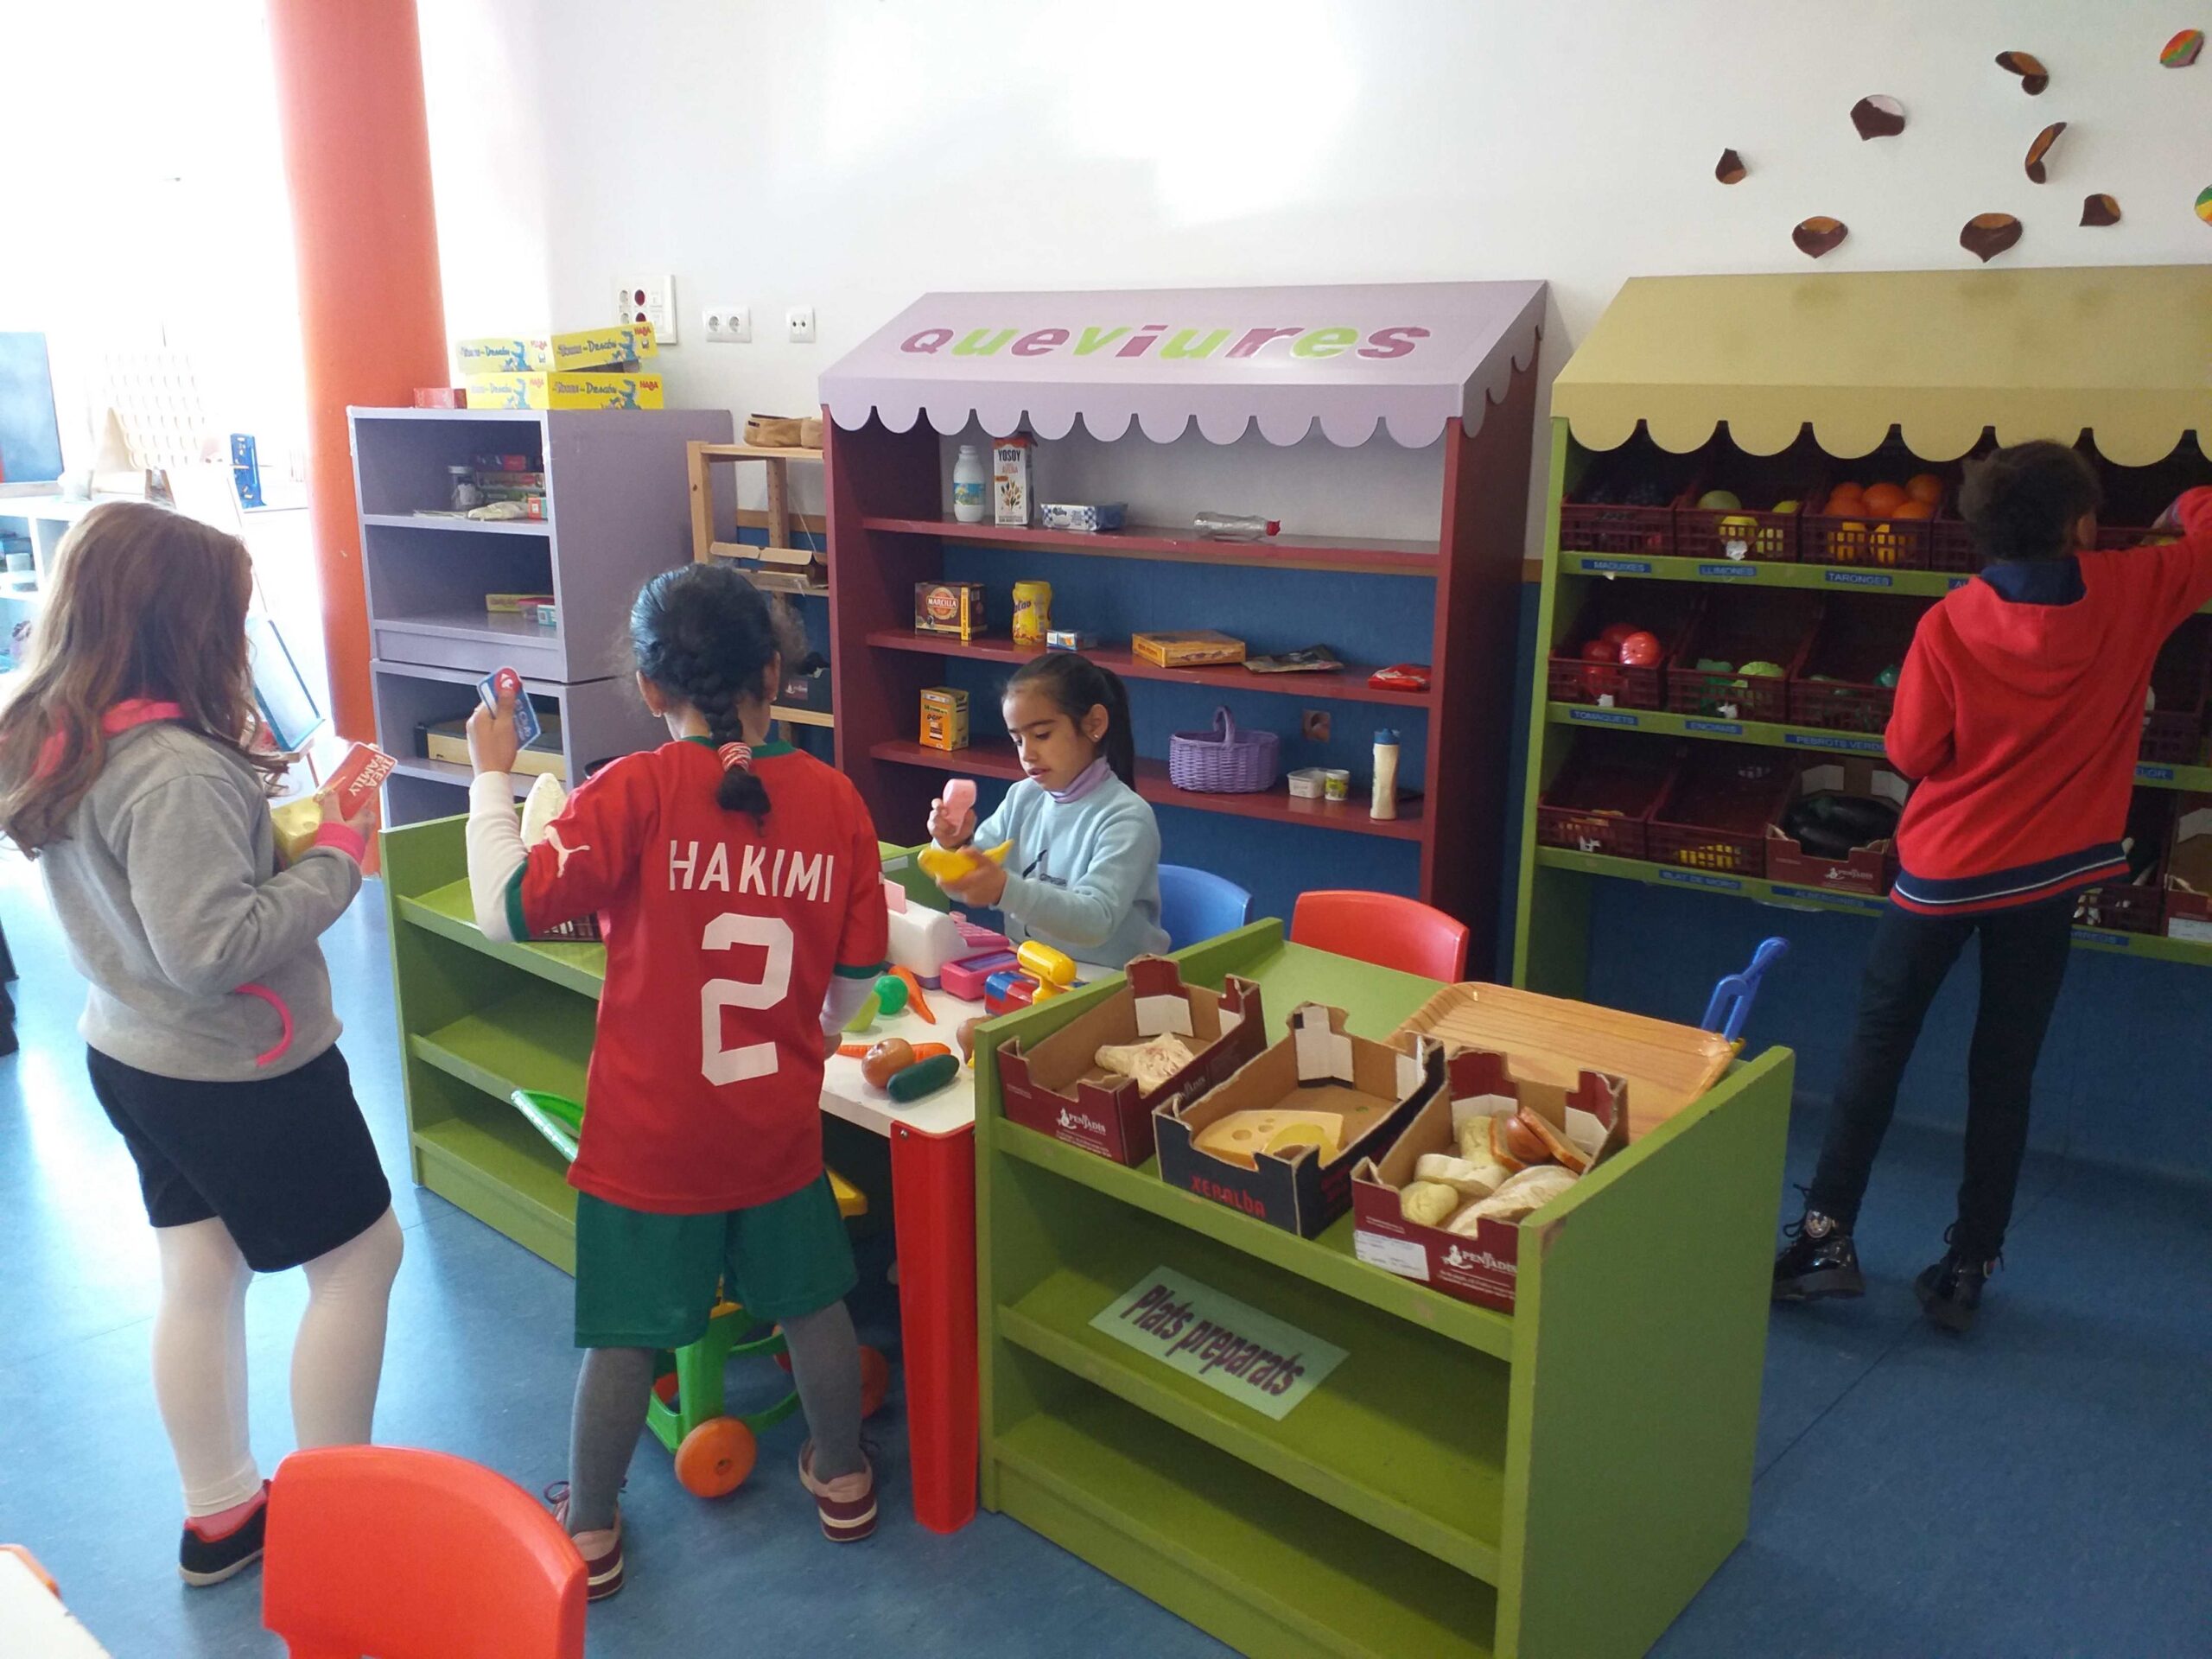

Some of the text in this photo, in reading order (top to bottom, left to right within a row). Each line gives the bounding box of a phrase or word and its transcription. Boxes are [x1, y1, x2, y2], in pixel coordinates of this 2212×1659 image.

[899, 324, 1431, 360] Queviures
[639, 380, 658, 391] HABA
[998, 449, 1020, 461] YOSOY
[1701, 567, 1755, 576] LLIMONES
[1828, 573, 1890, 586] TARONGES
[927, 598, 957, 608] MARCILLA
[1574, 710, 1635, 724] TOMAQUETS
[1796, 736, 1847, 748] PEBROTS
[348, 753, 384, 797] FAMILY
[365, 759, 395, 787] IKEA
[669, 839, 835, 903] HAKIMI
[701, 912, 794, 1087] 2
[1119, 1283, 1306, 1396] Plats preparats
